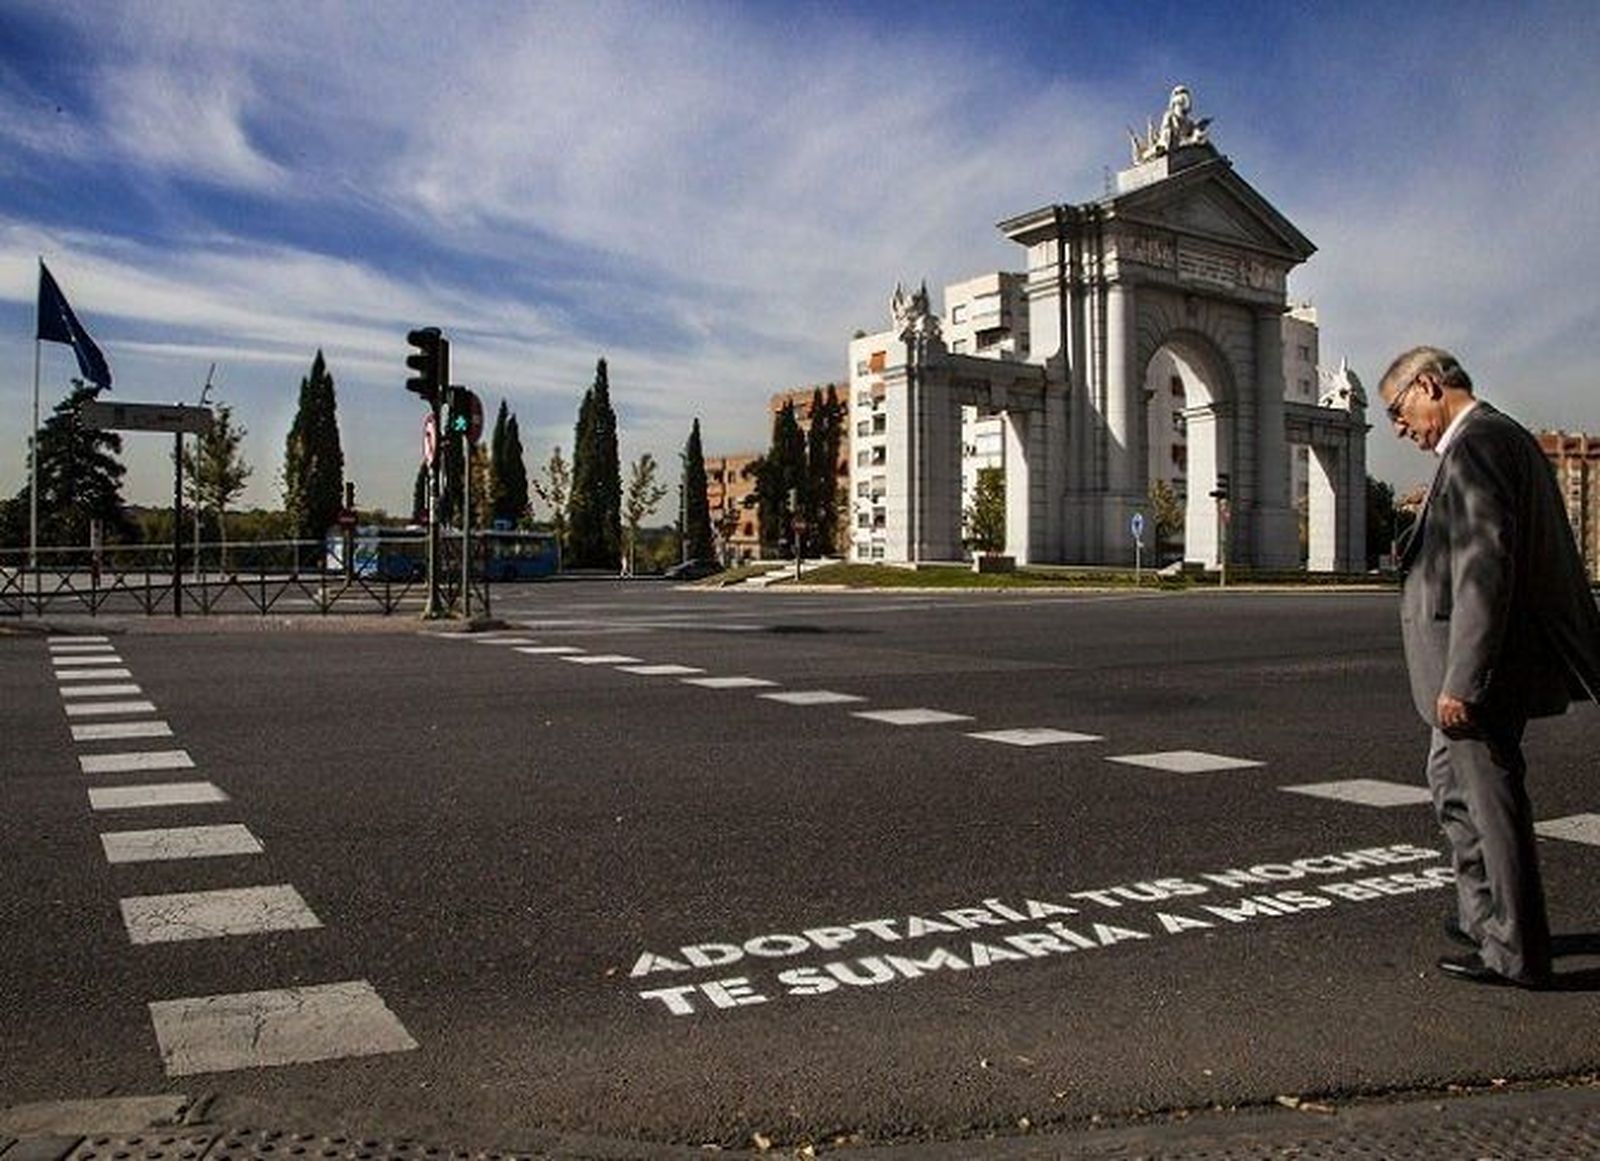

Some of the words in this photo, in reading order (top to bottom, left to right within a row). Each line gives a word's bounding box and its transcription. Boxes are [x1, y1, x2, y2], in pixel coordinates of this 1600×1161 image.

[629, 898, 1079, 977] ADOPTARÍA
[1069, 877, 1208, 907] TUS
[1201, 844, 1442, 888] NOCHES
[639, 976, 767, 1016] TE
[778, 922, 1151, 996] SUMARÍA
[1156, 911, 1216, 934] A
[1203, 890, 1332, 923] MIS
